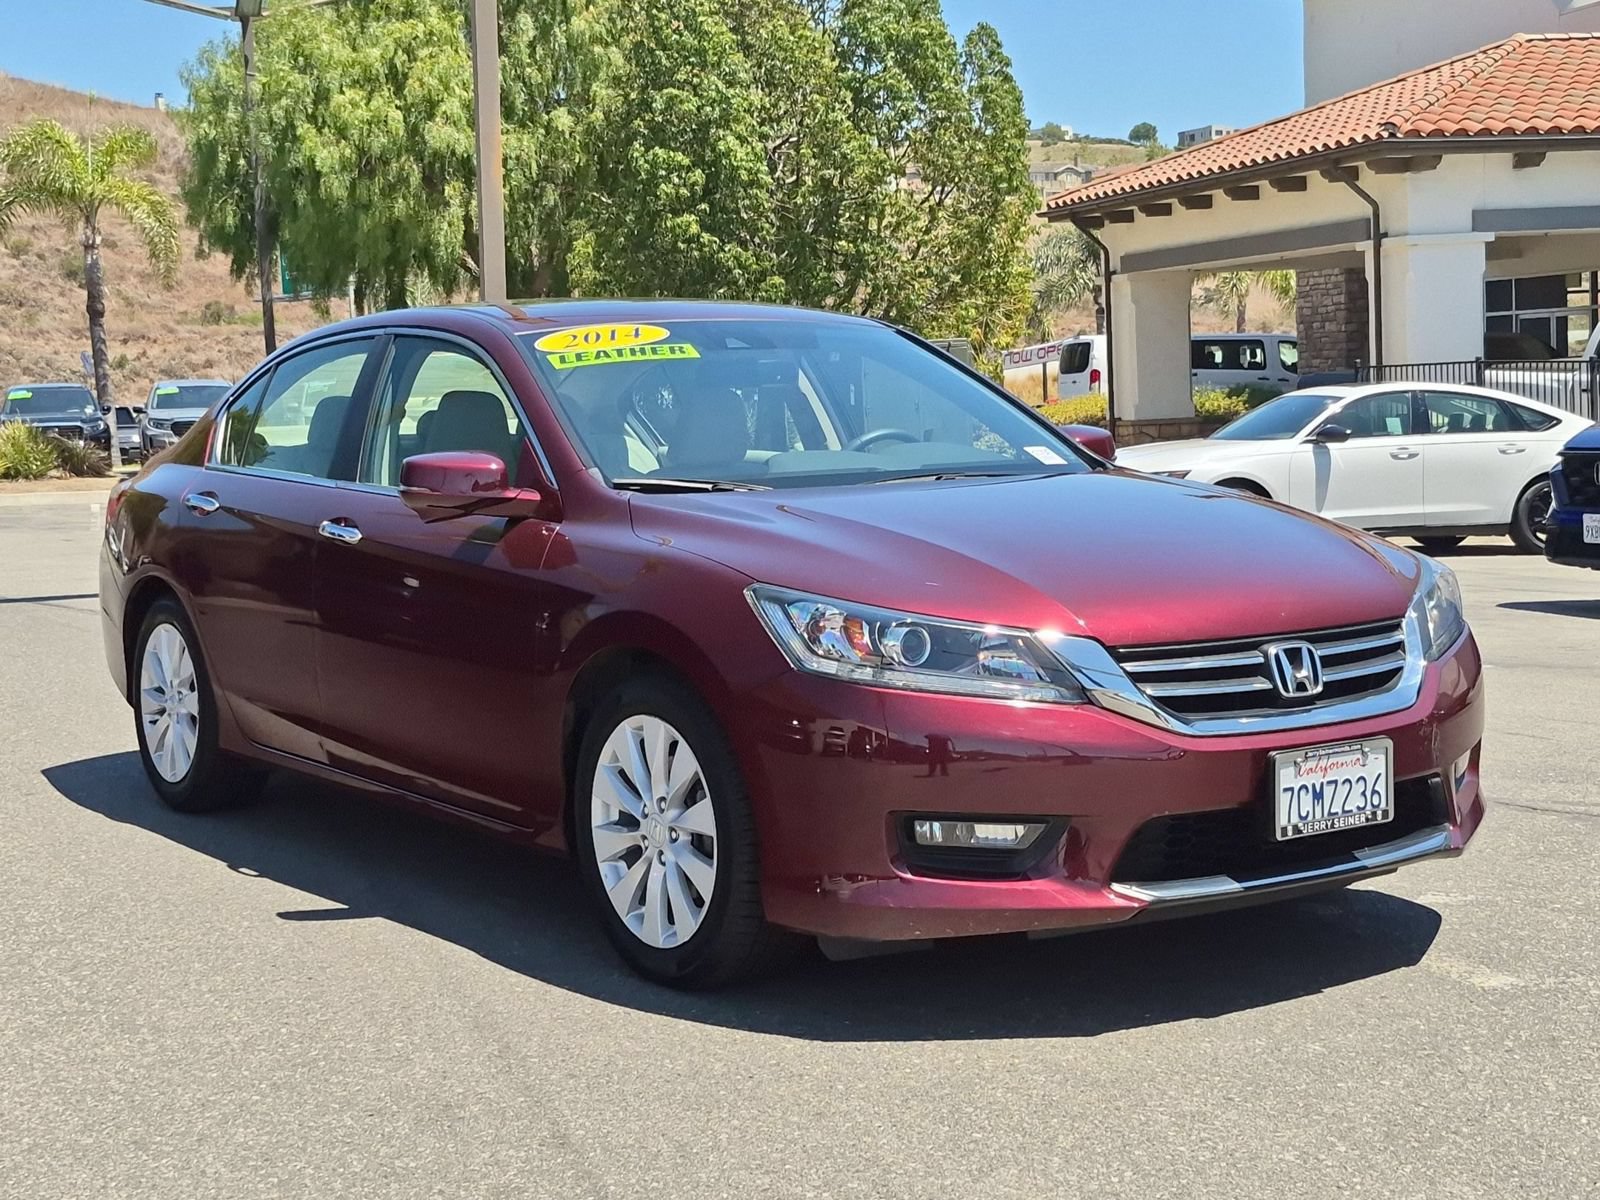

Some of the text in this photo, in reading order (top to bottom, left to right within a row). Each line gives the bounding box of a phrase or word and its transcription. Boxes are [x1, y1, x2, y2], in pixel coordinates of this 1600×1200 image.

[563, 327, 642, 349] 2014
[559, 345, 687, 364] LEATHER
[1297, 755, 1362, 779] California
[1282, 772, 1382, 824] 7CMZ236
[1302, 813, 1366, 834] JERRY SEINER
